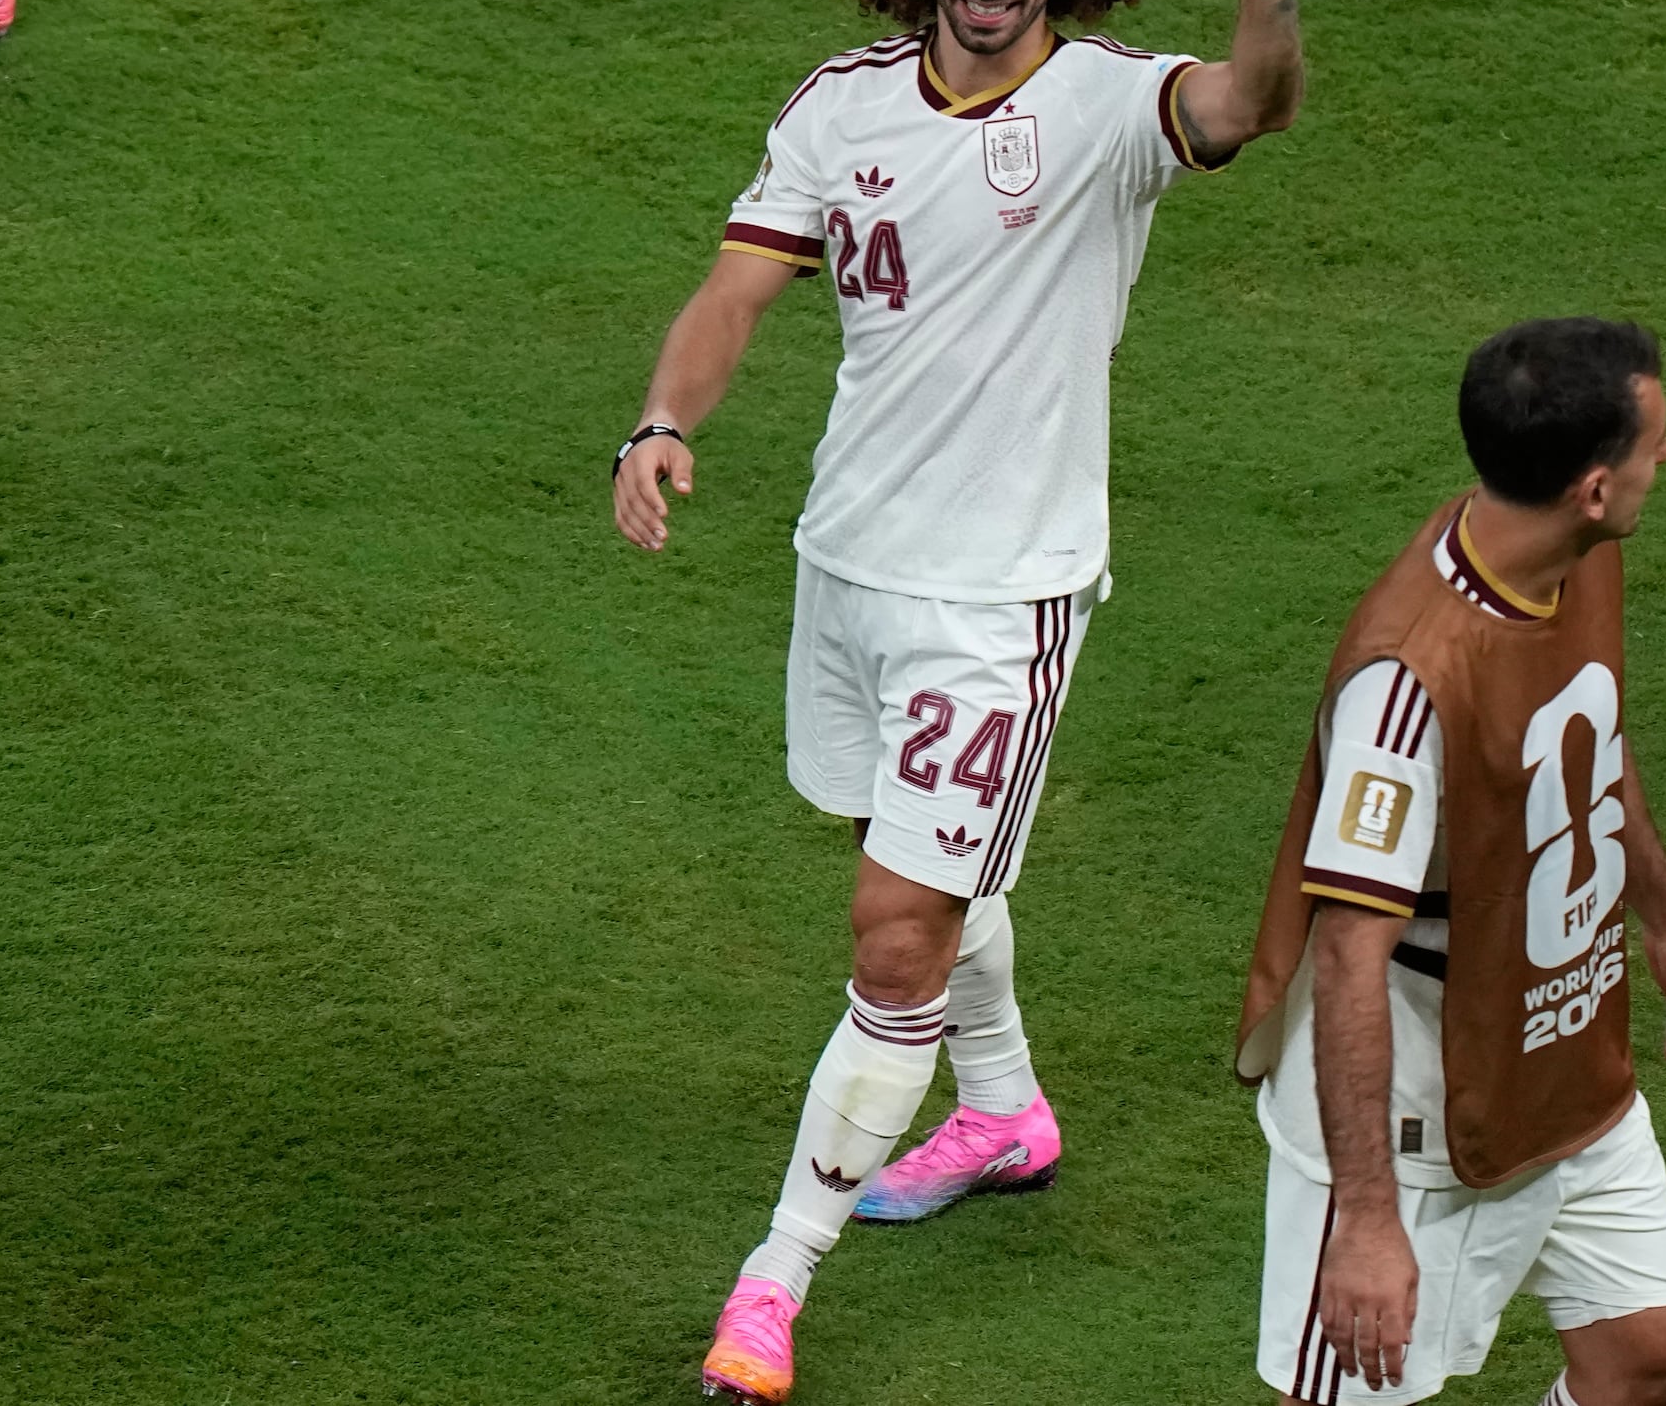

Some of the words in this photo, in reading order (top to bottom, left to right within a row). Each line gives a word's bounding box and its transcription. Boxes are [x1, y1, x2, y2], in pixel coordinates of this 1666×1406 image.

[827, 206, 910, 312] 24
[896, 690, 1018, 810] 24
[1523, 951, 1624, 1054] 206
